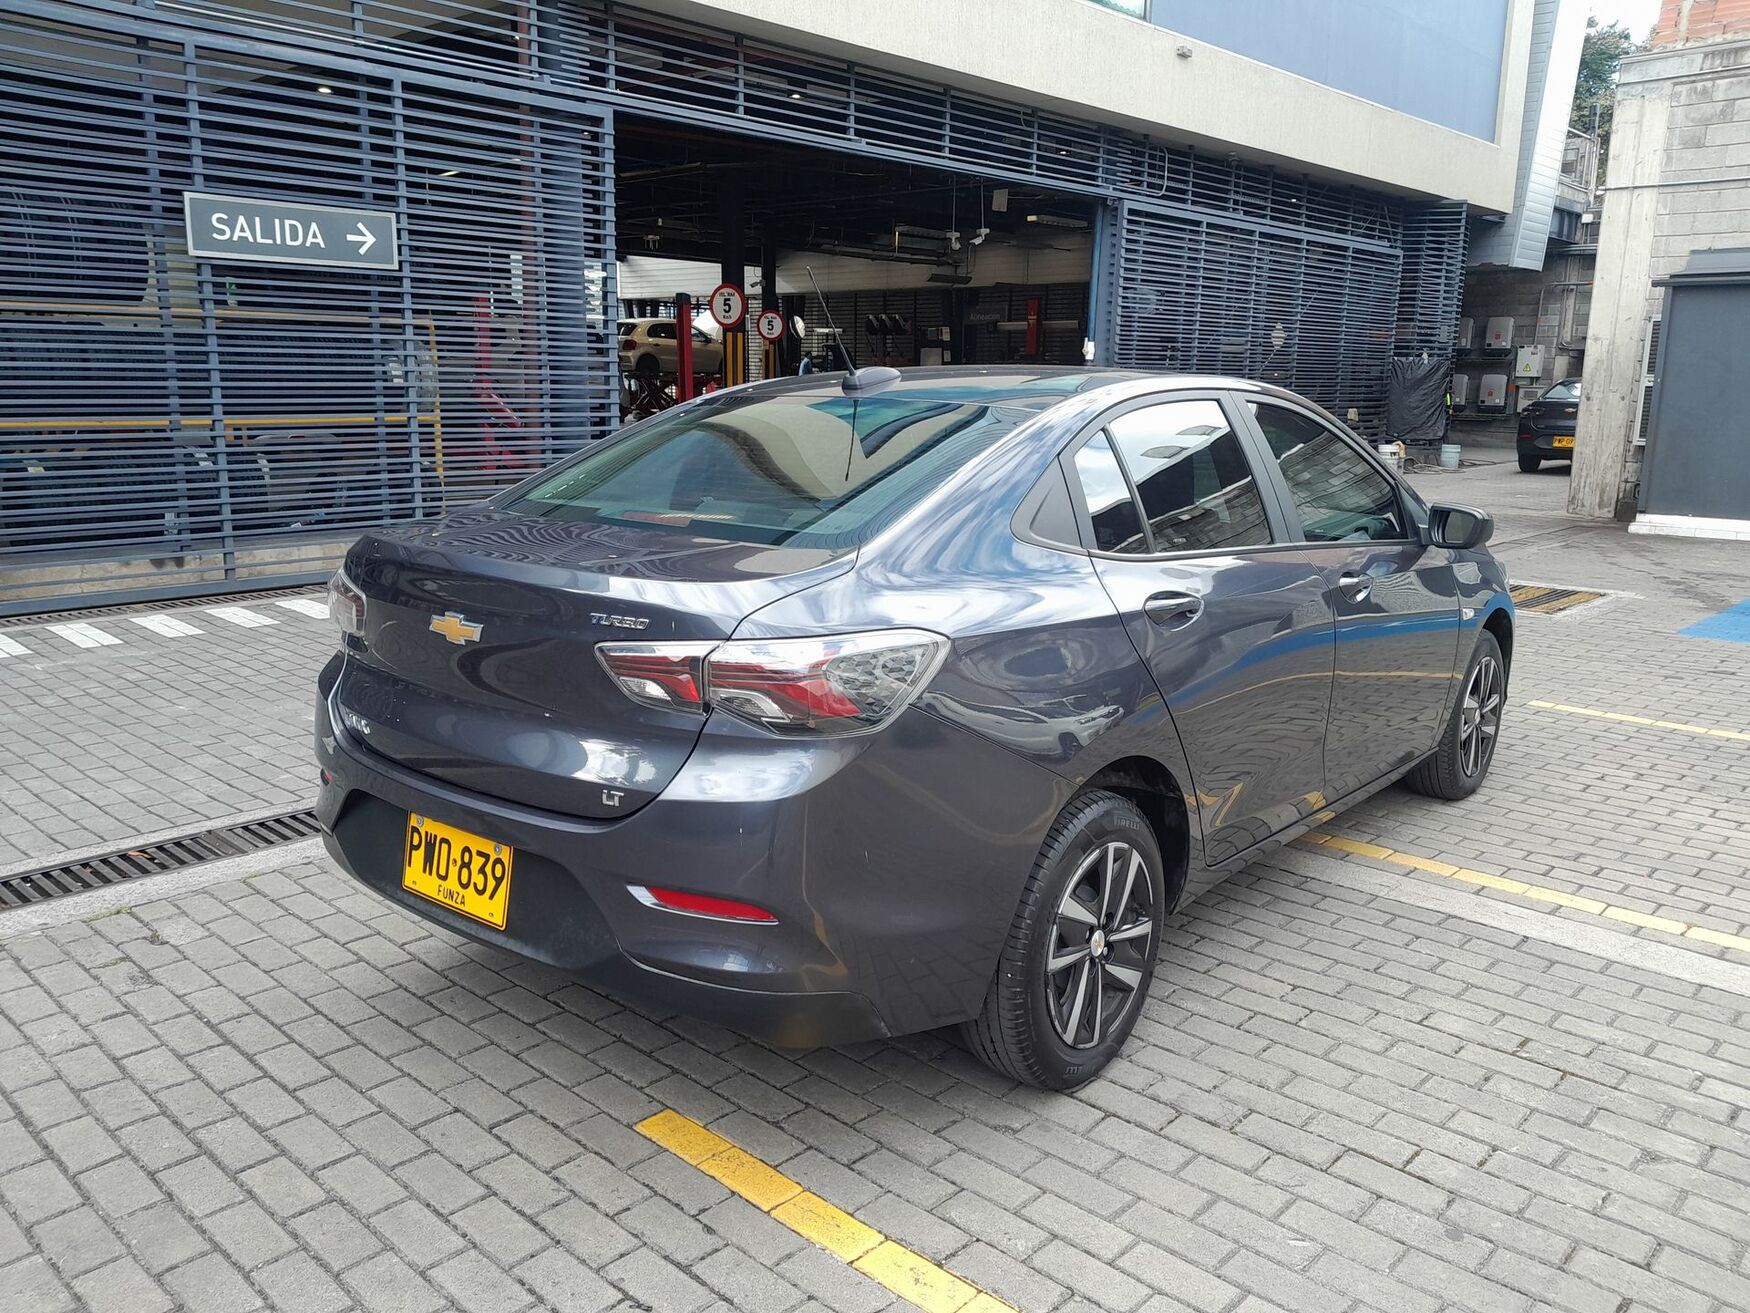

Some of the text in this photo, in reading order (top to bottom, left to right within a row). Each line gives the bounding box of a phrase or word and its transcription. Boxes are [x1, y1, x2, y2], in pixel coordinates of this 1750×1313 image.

[210, 212, 326, 248] SALIDA
[723, 298, 732, 313] 5
[767, 320, 774, 331] 5
[590, 612, 650, 630] TURBO
[602, 789, 624, 807] LT
[437, 884, 466, 907] FUNZA
